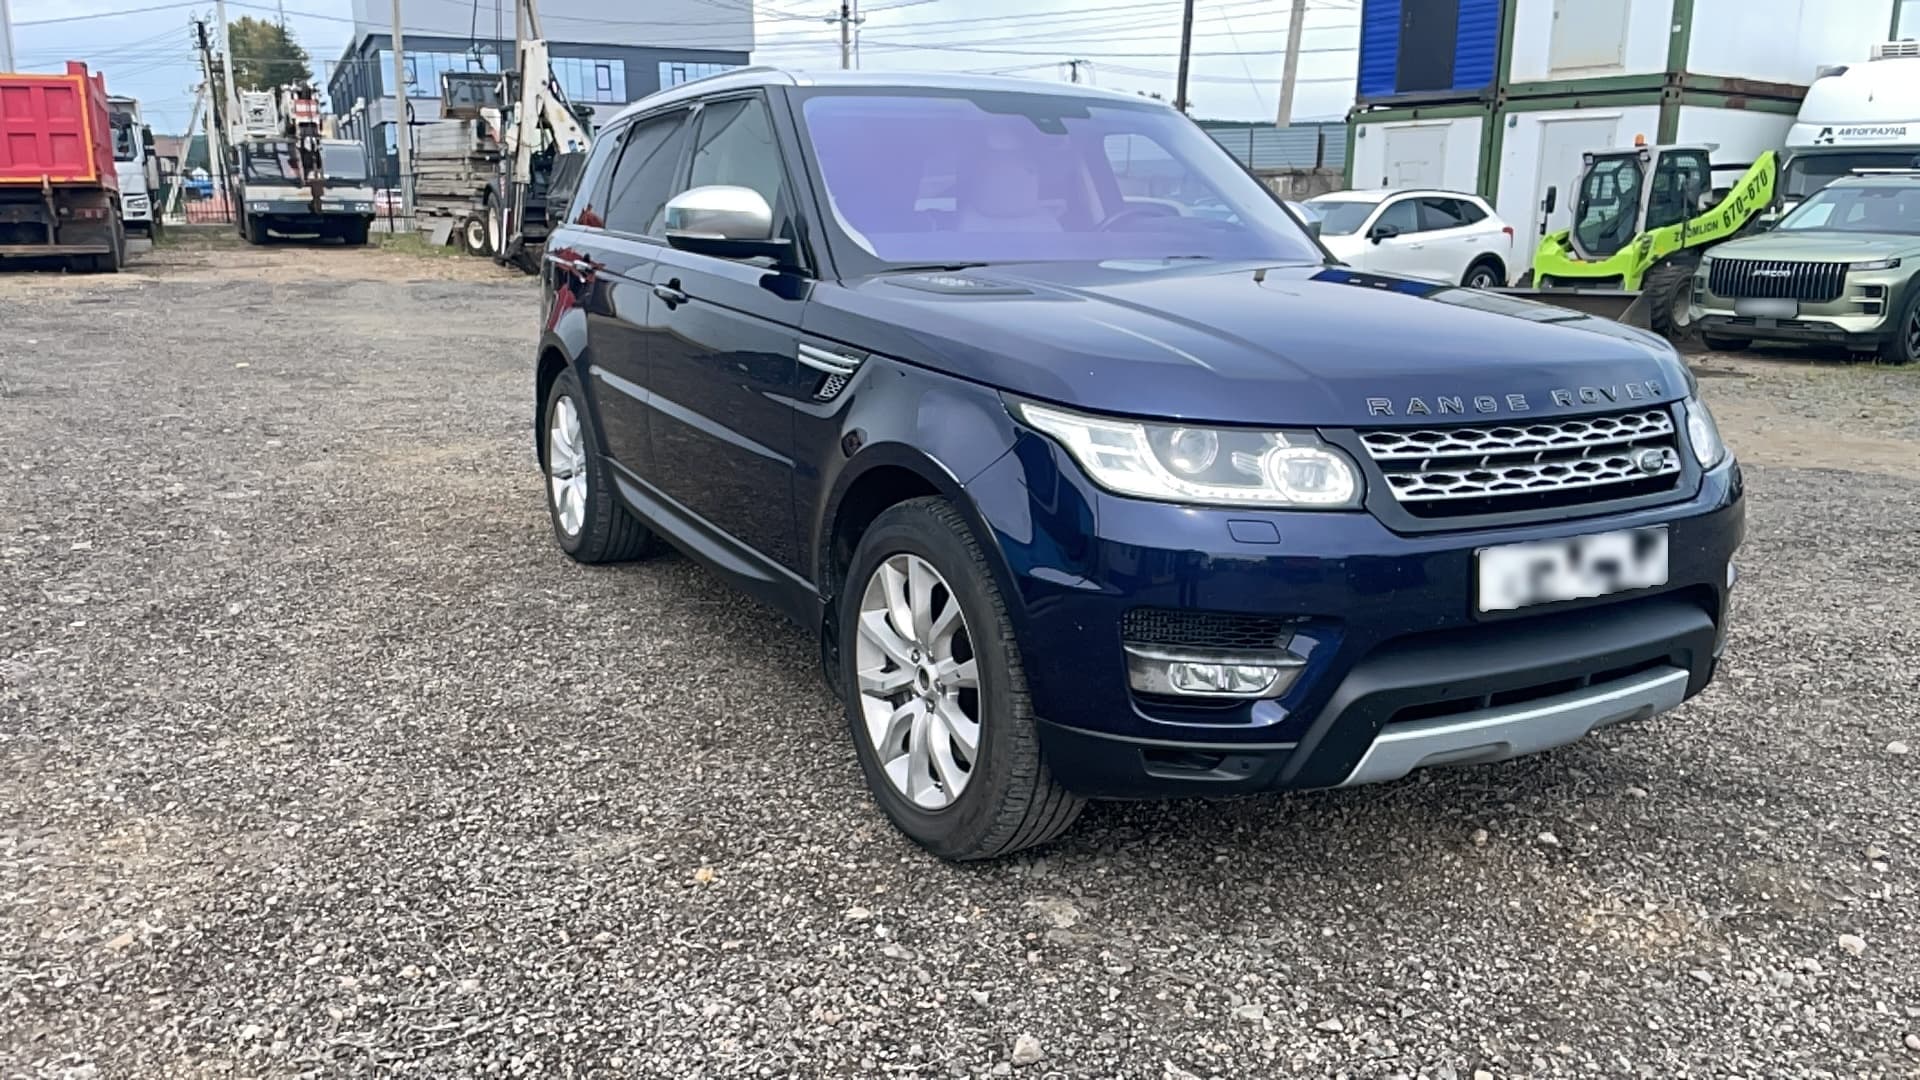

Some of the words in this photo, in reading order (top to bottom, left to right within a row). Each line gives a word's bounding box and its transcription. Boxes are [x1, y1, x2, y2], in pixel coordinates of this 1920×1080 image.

[1838, 127, 1907, 136] АВТОГРАУНД
[1722, 168, 1768, 229] 670-670
[1366, 393, 1530, 416] RANGE
[1550, 381, 1663, 407] ROVER
